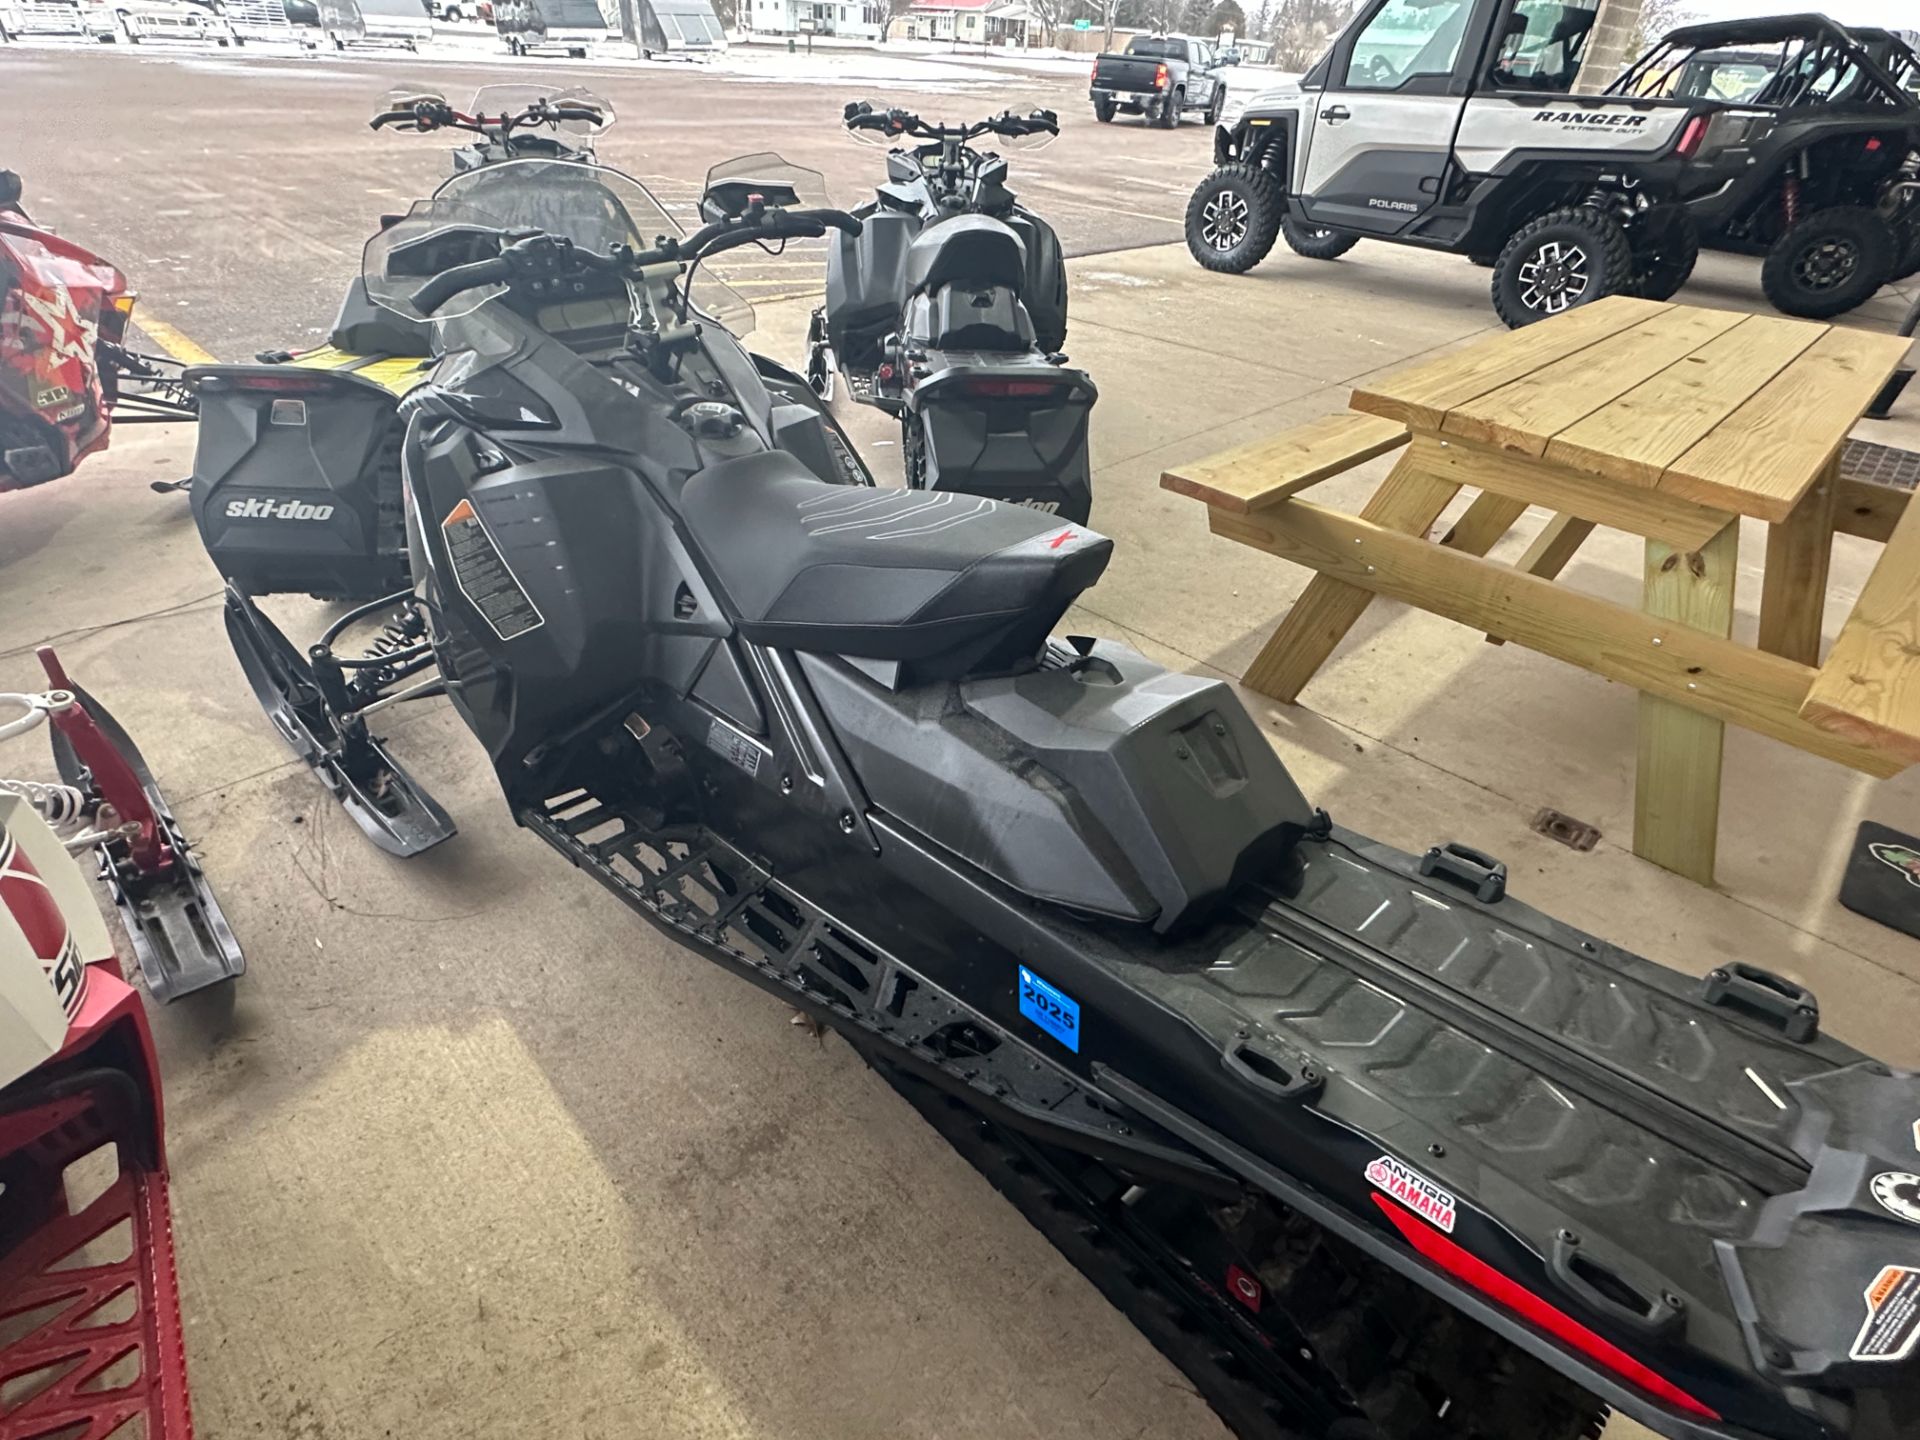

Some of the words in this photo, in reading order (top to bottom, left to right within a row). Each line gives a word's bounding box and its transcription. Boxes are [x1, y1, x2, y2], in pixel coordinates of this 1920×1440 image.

[1533, 111, 1647, 126] RANGER
[1369, 198, 1418, 212] POLARIS
[225, 498, 334, 520] ski-doo
[1024, 984, 1075, 1030] 2025
[1381, 1159, 1451, 1207] ANTIGO
[1389, 1173, 1453, 1228] YAMAHA
